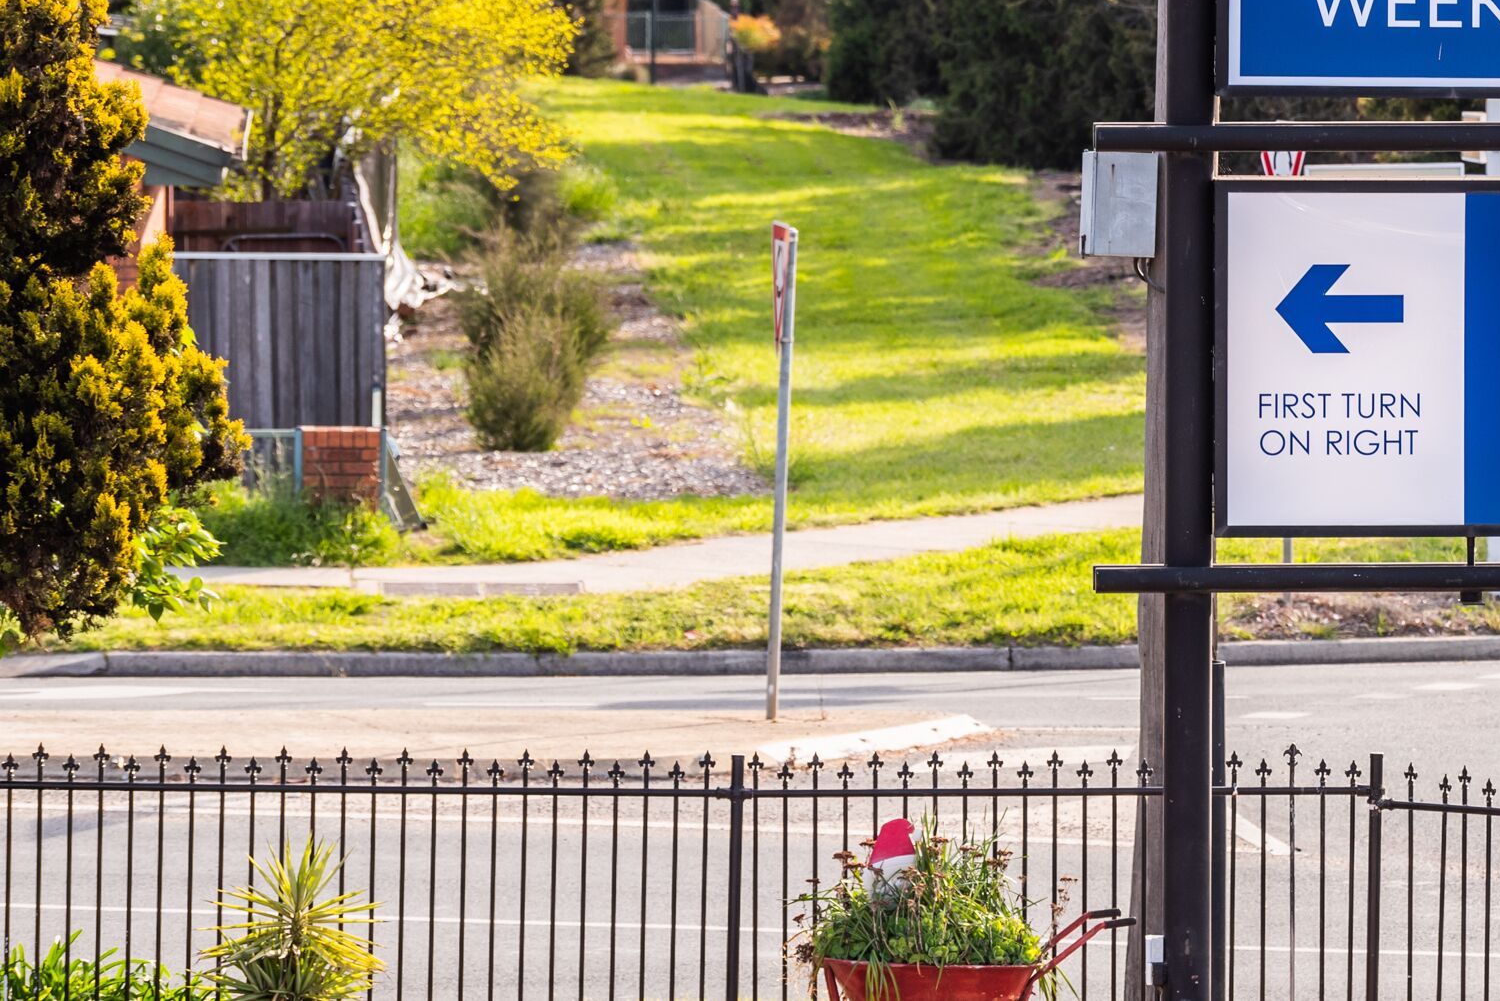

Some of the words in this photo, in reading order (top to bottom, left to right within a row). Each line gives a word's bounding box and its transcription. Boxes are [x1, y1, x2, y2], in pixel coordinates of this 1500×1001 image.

[1258, 392, 1331, 419] FIRST
[1341, 392, 1421, 419] TURN
[1259, 429, 1310, 457] ON
[1326, 429, 1419, 456] RIGHT
